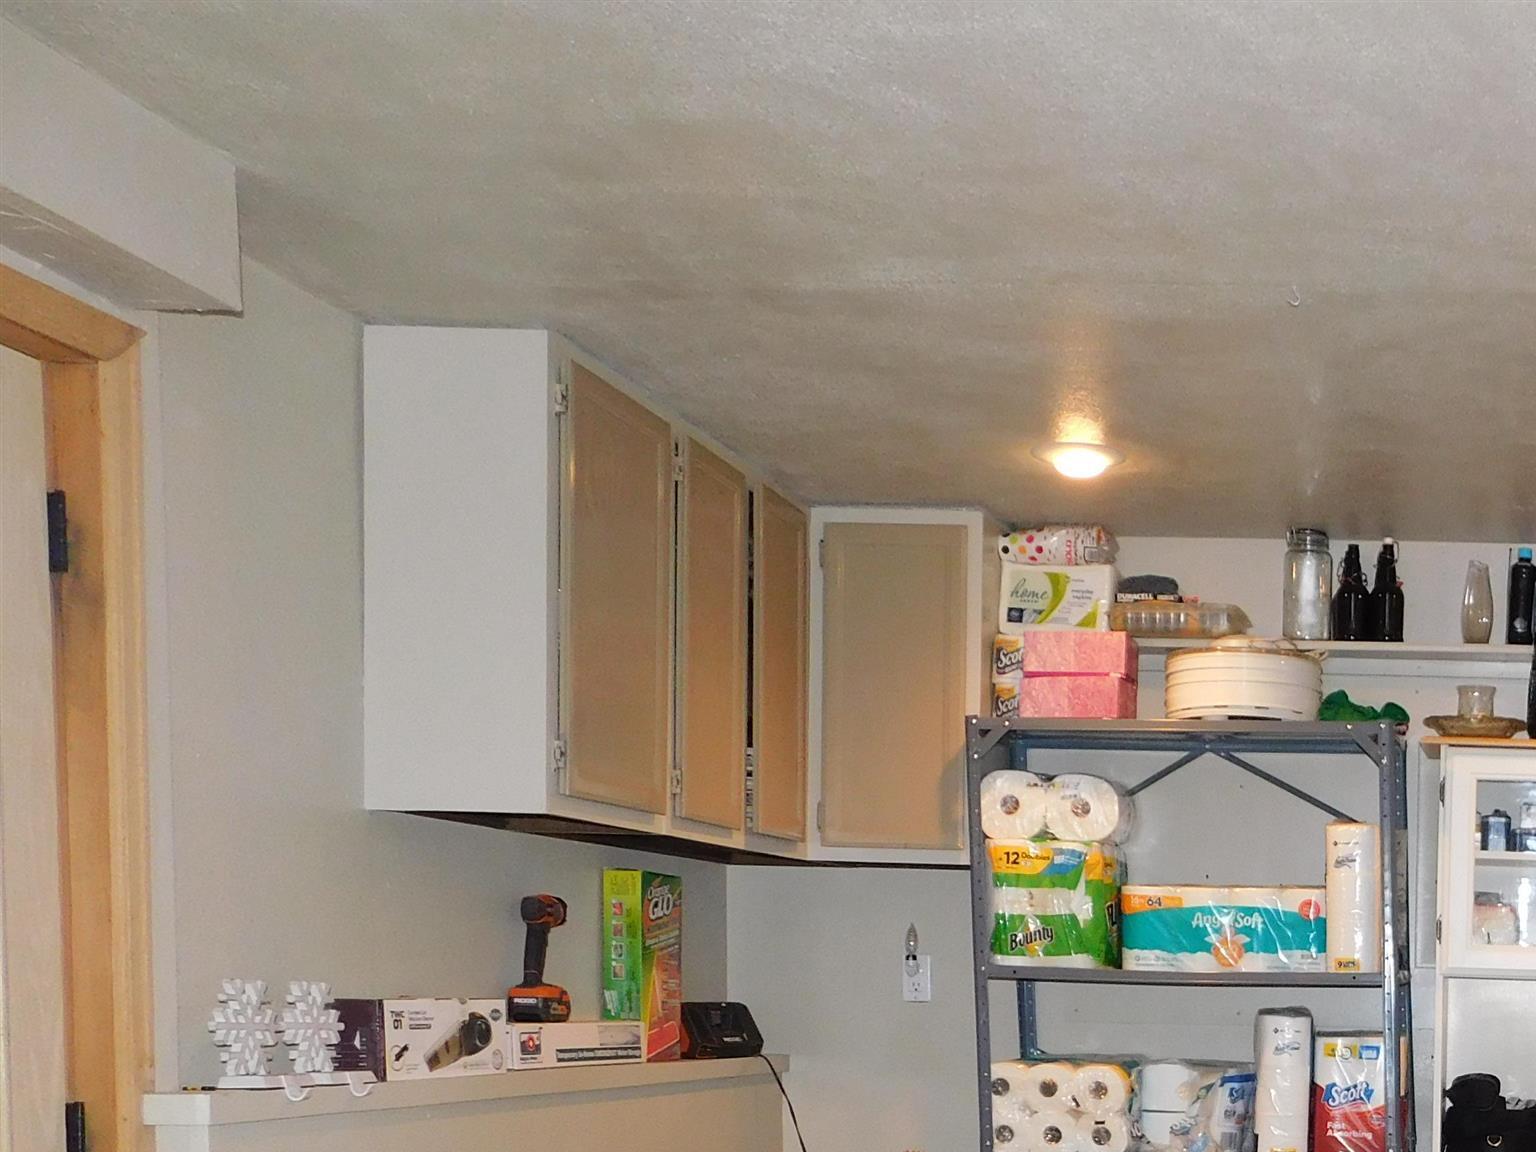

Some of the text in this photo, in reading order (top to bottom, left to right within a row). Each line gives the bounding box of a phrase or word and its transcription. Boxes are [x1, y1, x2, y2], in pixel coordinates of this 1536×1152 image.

[1010, 577, 1048, 599] home
[1004, 851, 1021, 865] 12
[649, 894, 673, 921] GLO
[1146, 896, 1163, 907] 64
[1235, 910, 1265, 929] Soft
[1008, 926, 1055, 952] Bounty
[1328, 1081, 1370, 1107] Scott
